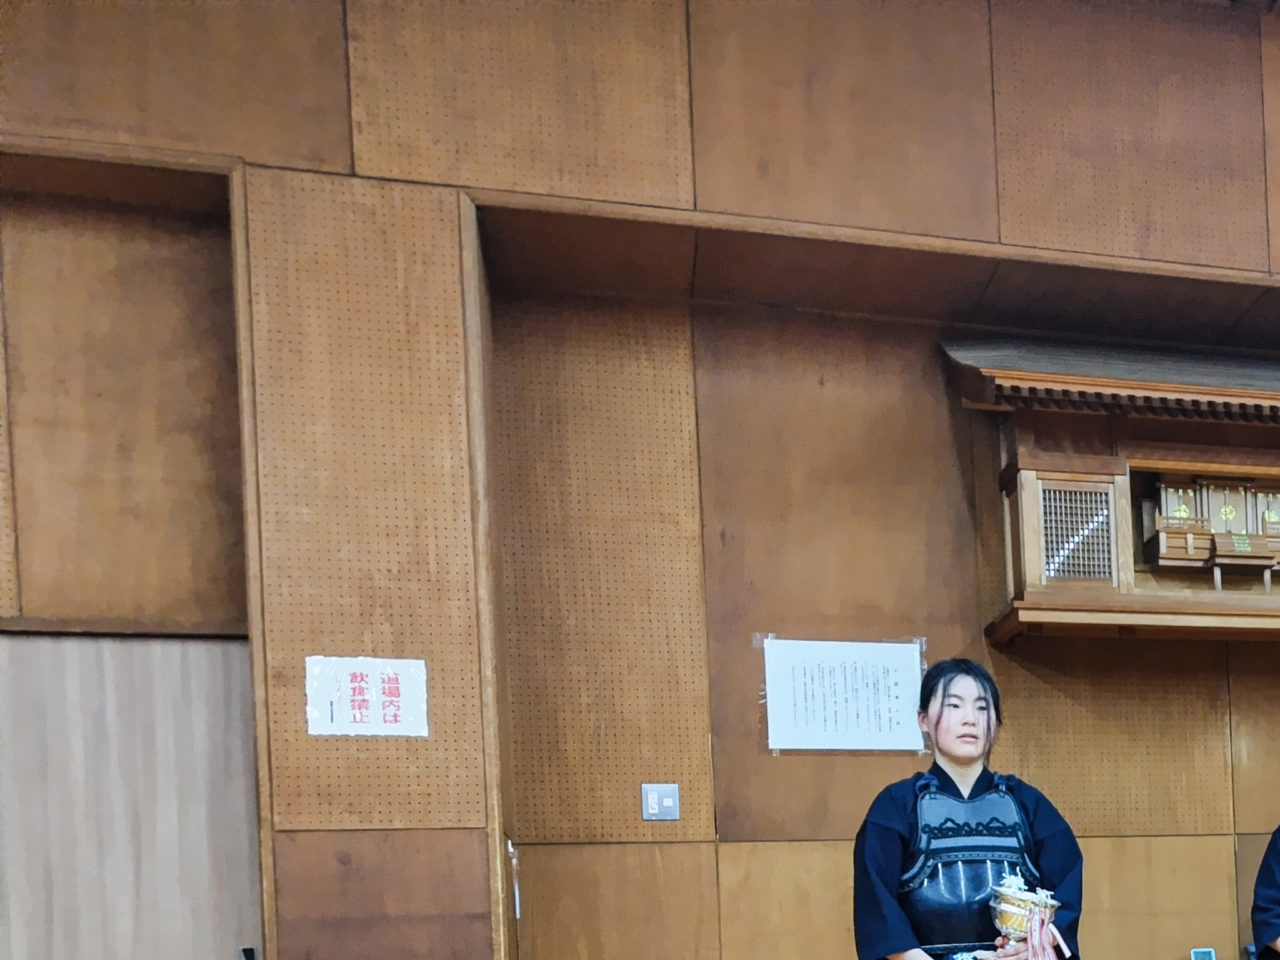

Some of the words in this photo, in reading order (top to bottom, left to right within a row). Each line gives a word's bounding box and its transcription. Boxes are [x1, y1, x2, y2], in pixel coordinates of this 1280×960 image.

[349, 672, 370, 724] 飲食禁止
[381, 673, 401, 724] 道場内は
